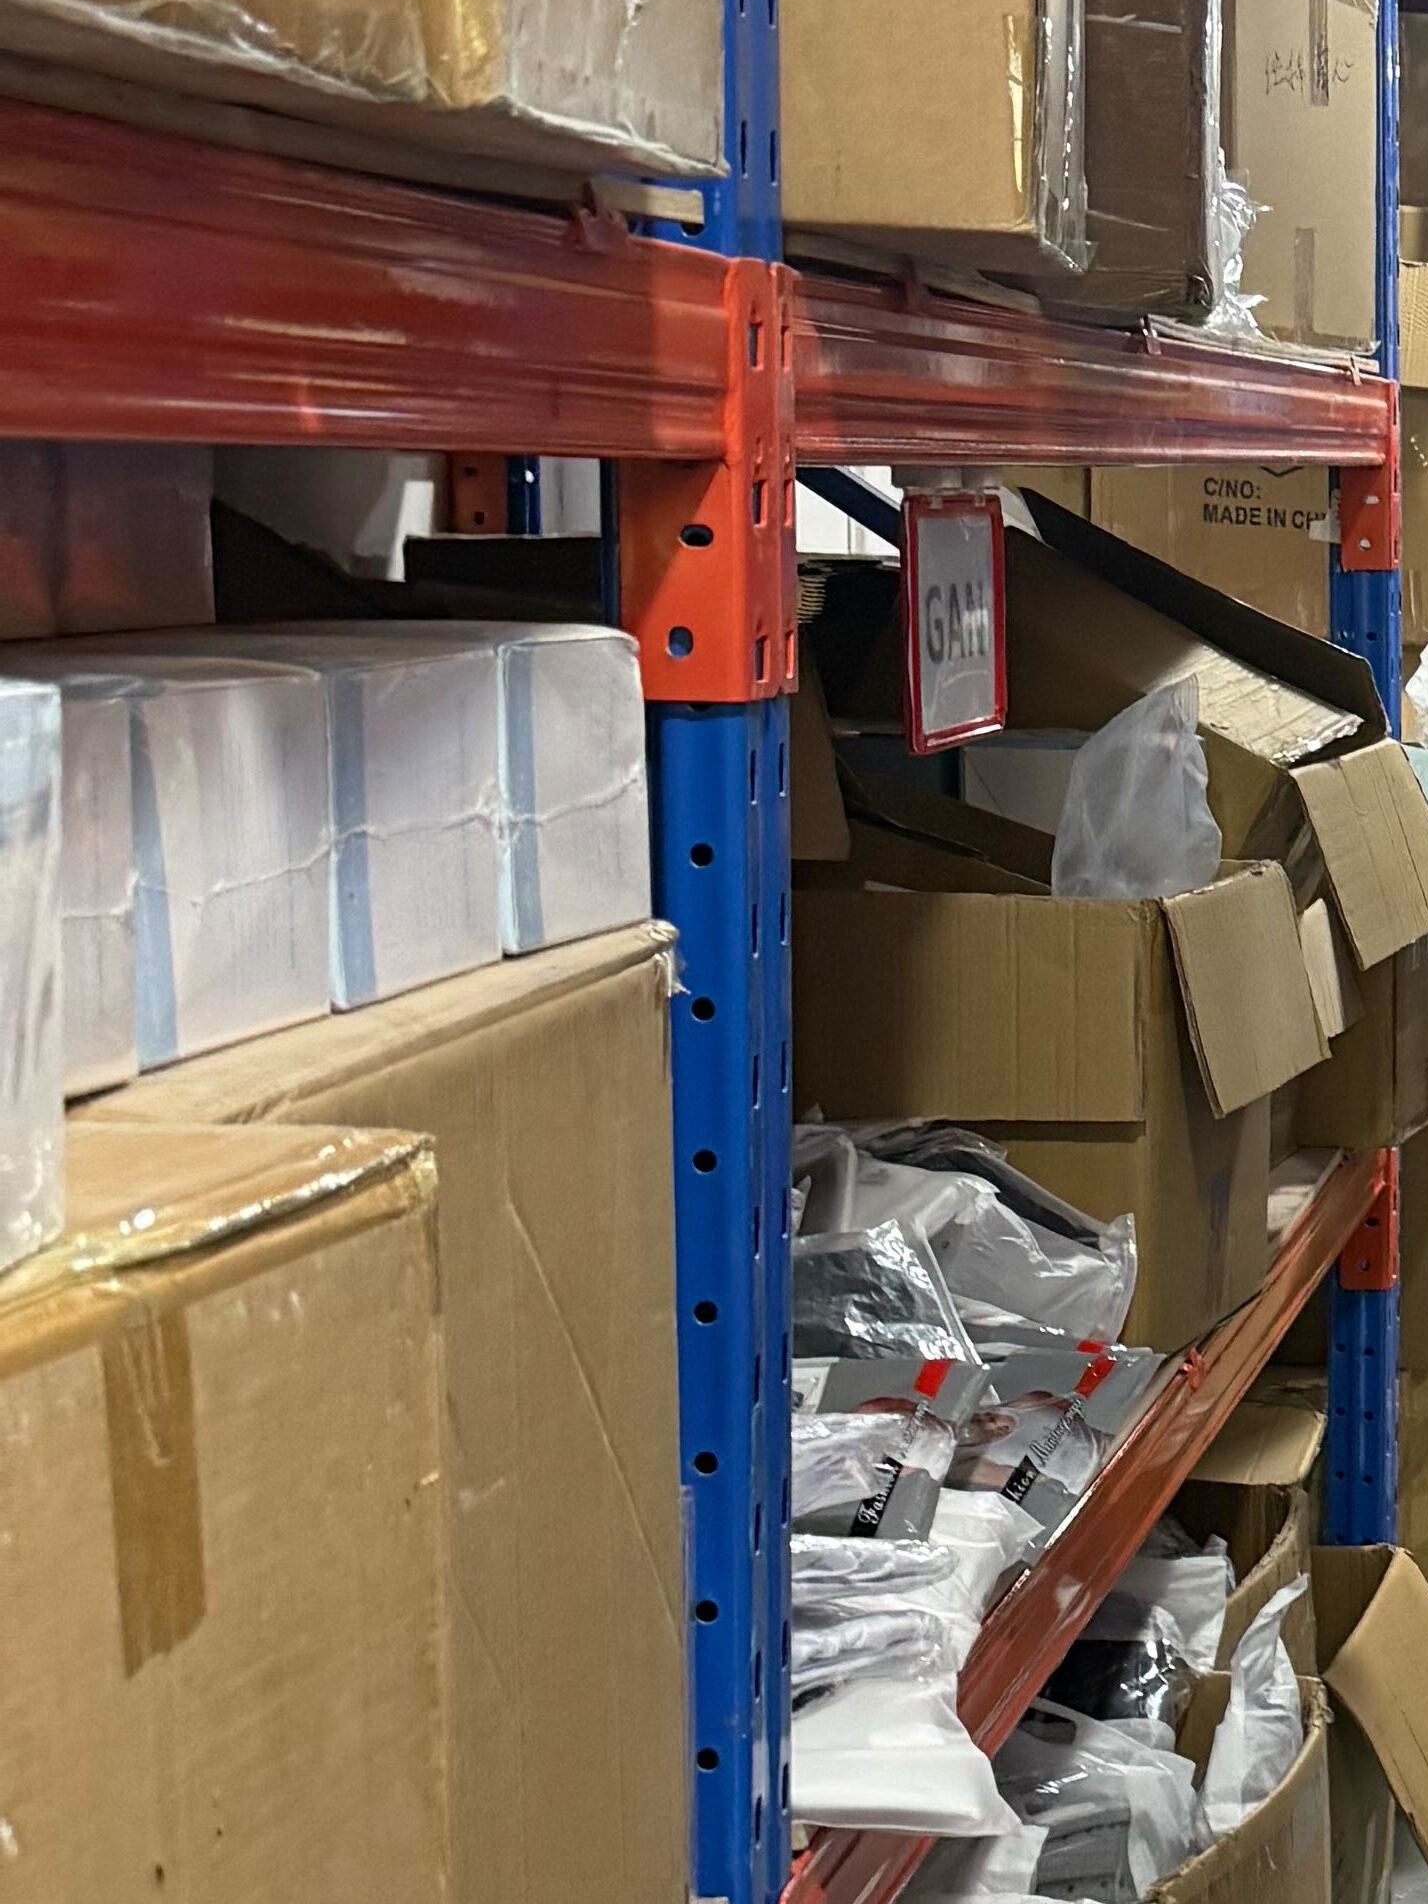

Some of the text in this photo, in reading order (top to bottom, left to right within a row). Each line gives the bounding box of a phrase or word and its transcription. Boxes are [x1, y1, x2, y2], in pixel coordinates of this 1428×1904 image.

[1203, 477, 1261, 500] C/NO:
[1203, 503, 1262, 526] MADE
[1266, 508, 1287, 528] IN
[925, 581, 986, 664] GAN
